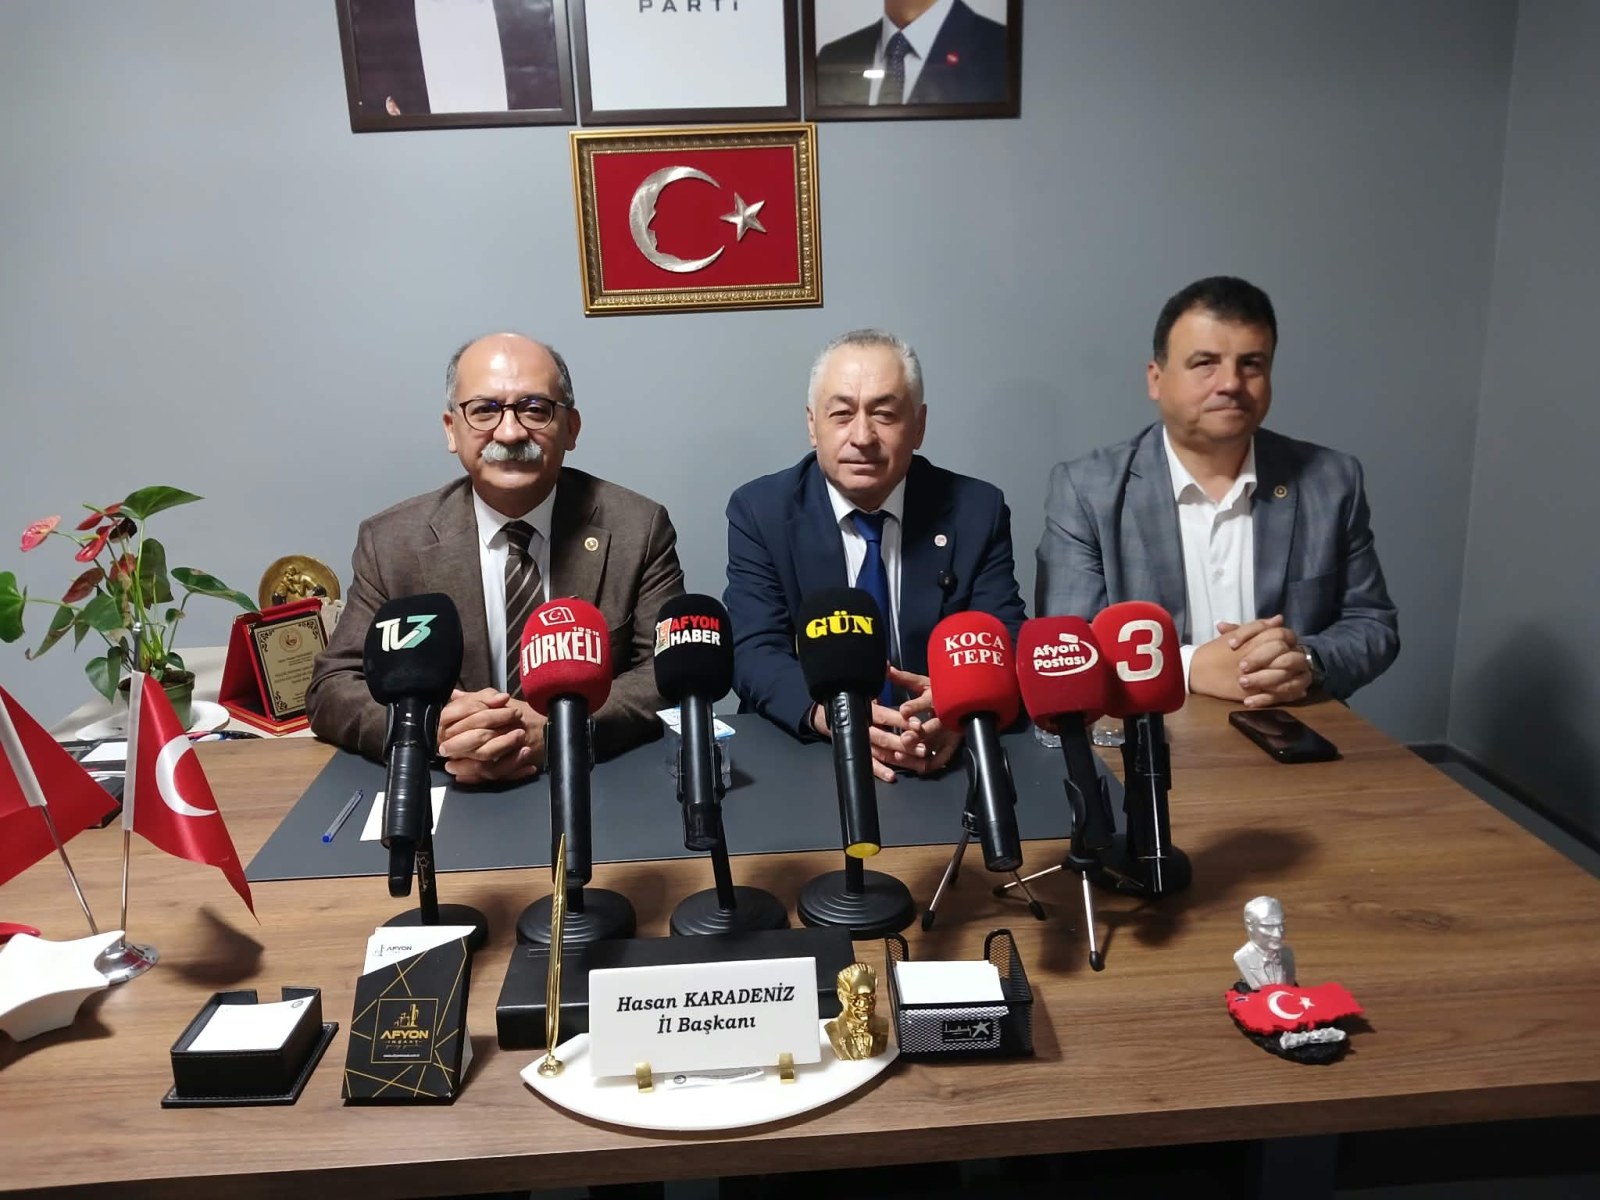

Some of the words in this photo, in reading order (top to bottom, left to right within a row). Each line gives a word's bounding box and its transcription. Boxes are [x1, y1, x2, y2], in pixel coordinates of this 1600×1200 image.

[670, 615, 720, 631] AFYON
[805, 610, 874, 639] GÜN
[670, 629, 721, 646] HABER
[943, 632, 1006, 651] KOCA
[949, 649, 1005, 667] TEPE
[1033, 643, 1080, 659] Afyon
[1116, 619, 1164, 682] 3
[1033, 655, 1086, 671] Postası
[616, 996, 678, 1012] Hasan
[683, 982, 795, 1008] KARADENİZ
[656, 1014, 672, 1034] İl
[677, 1014, 757, 1035] Başkanı
[380, 1030, 429, 1040] AFYON
